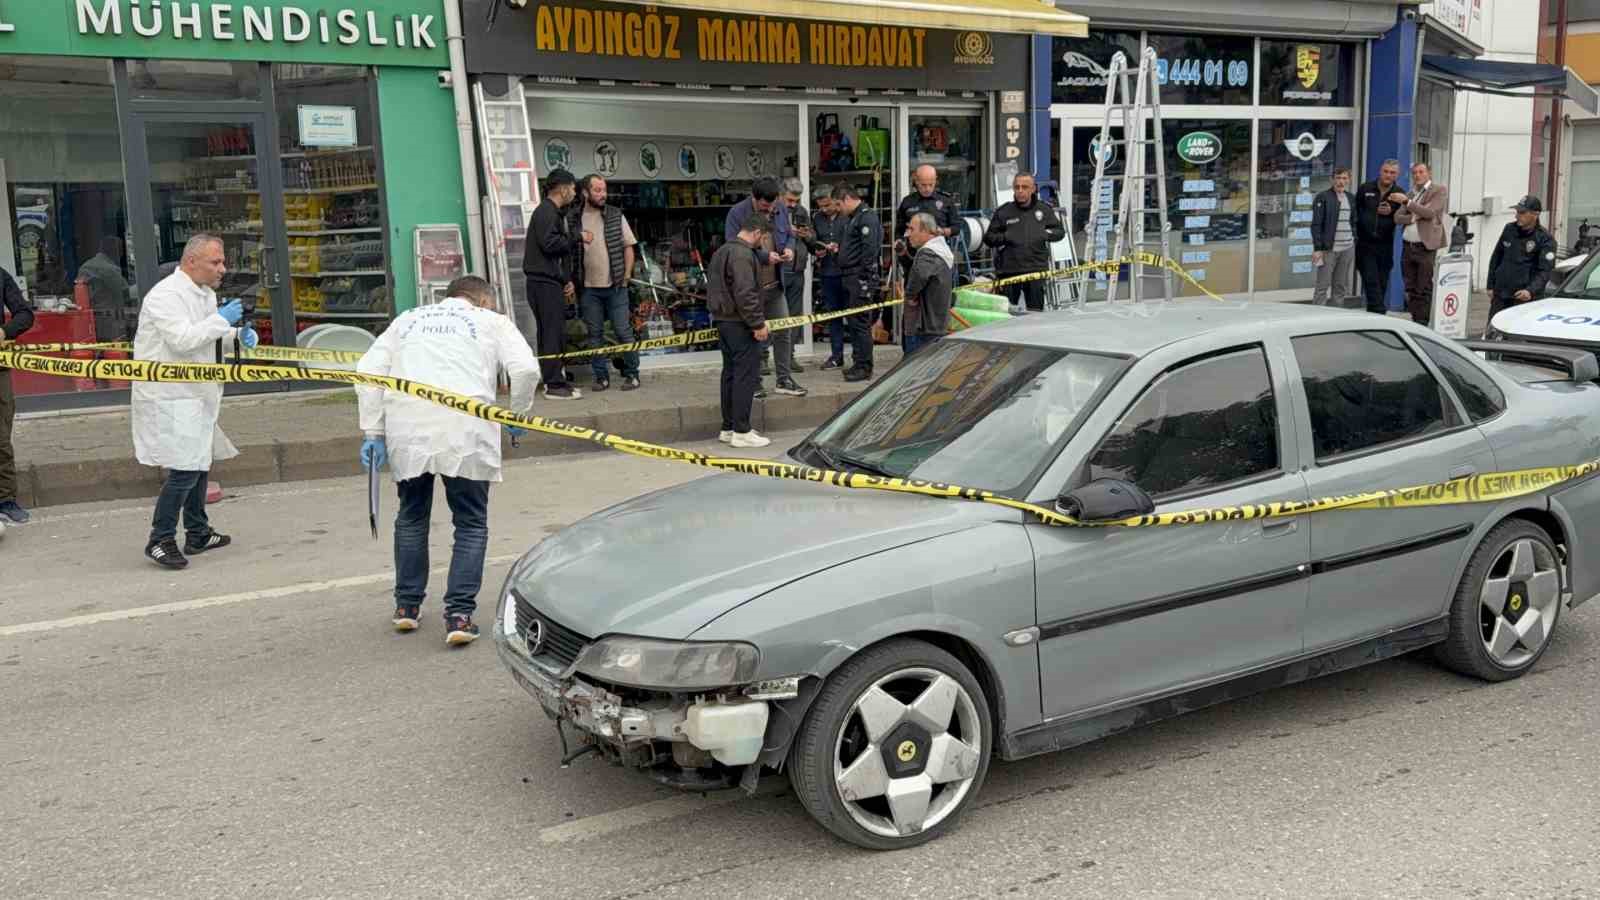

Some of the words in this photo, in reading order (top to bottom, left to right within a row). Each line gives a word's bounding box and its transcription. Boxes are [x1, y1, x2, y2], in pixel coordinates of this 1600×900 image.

[535, 4, 681, 59] AYDINGÖZ
[697, 16, 801, 64] MAKİNA
[810, 23, 927, 68] HIRDAVAT
[1169, 58, 1201, 86] 444
[1204, 59, 1223, 86] 01
[1228, 60, 1248, 86] 09
[1056, 76, 1108, 86] JAGUA
[1536, 313, 1600, 326] PO
[102, 362, 143, 378] POLİS
